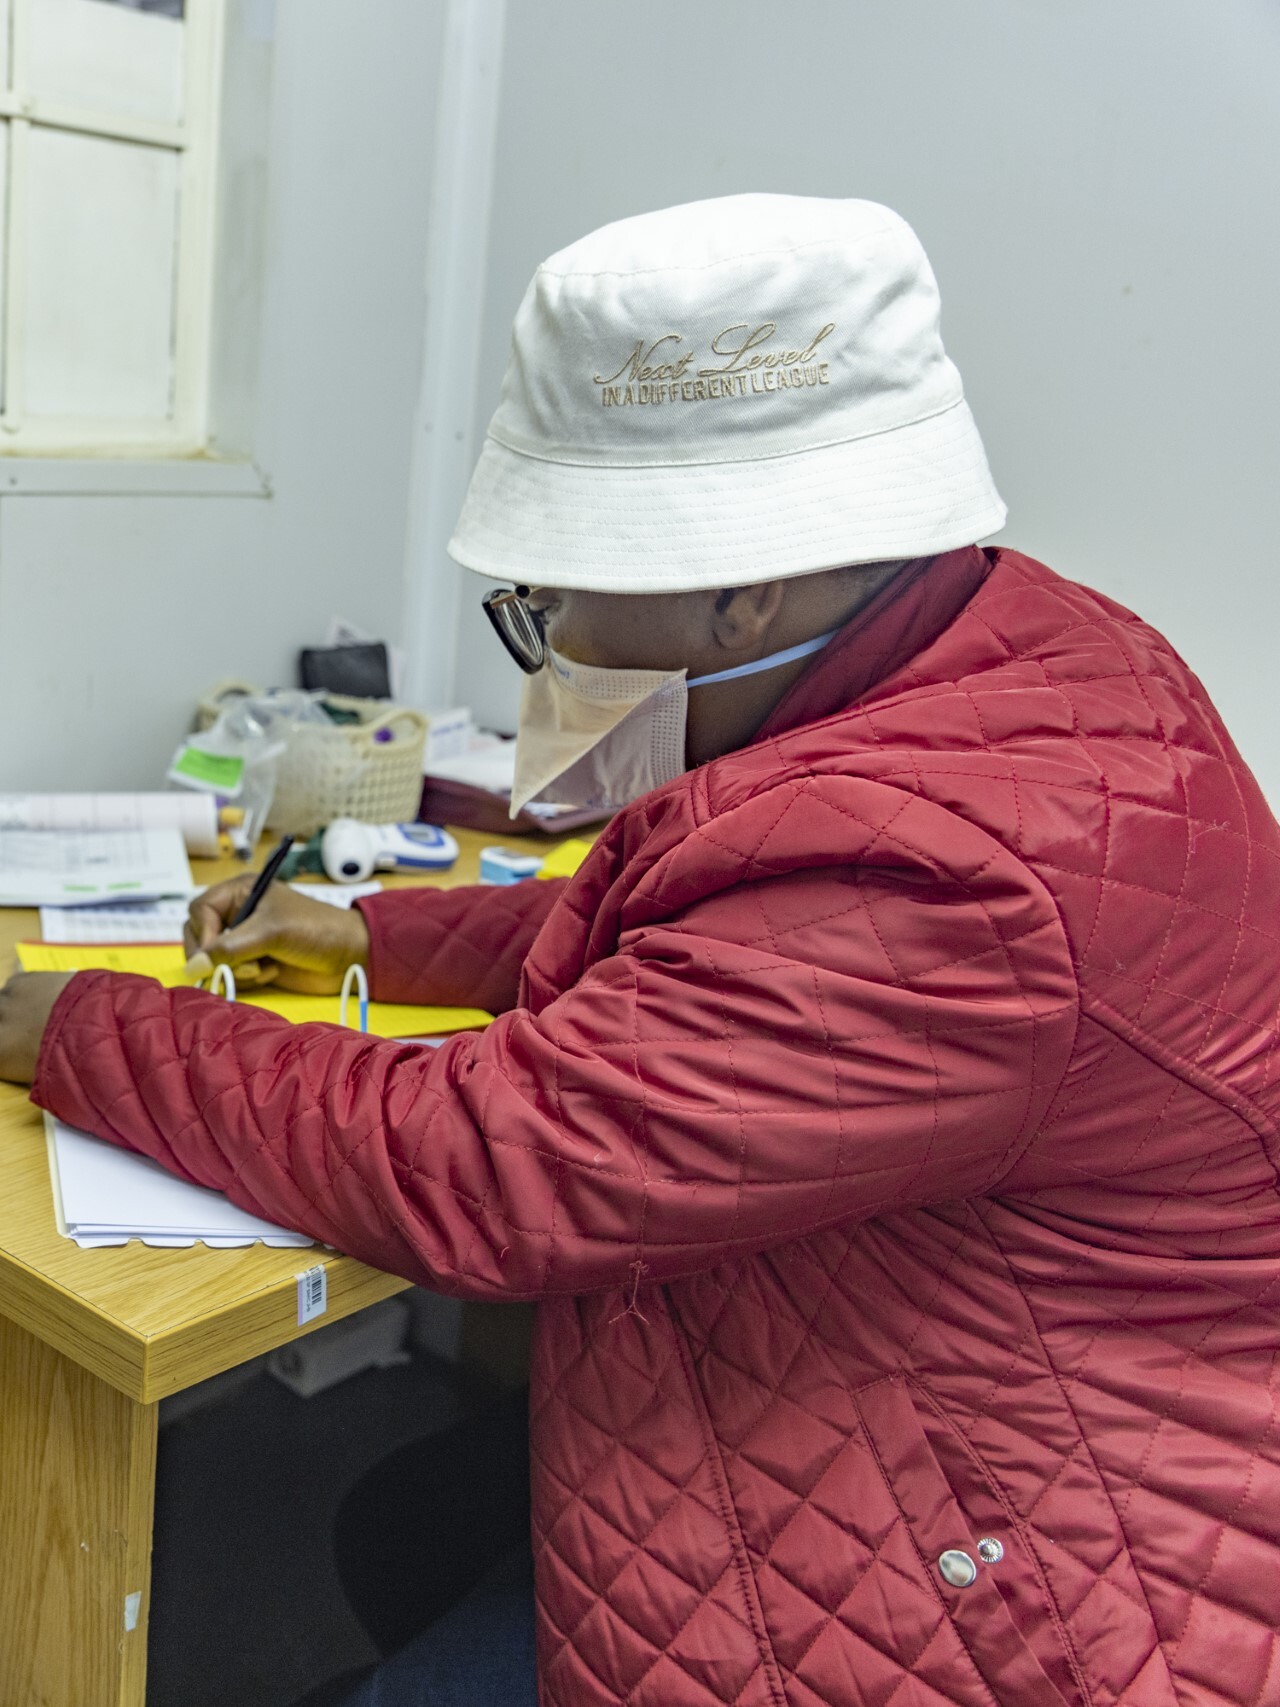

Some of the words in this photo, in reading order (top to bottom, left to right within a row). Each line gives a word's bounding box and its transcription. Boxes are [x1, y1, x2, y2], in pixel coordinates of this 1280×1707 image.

[593, 334, 694, 384] Next
[697, 321, 836, 378] Level
[638, 373, 747, 405] DIFFERENT
[751, 362, 830, 393] LEAGUE
